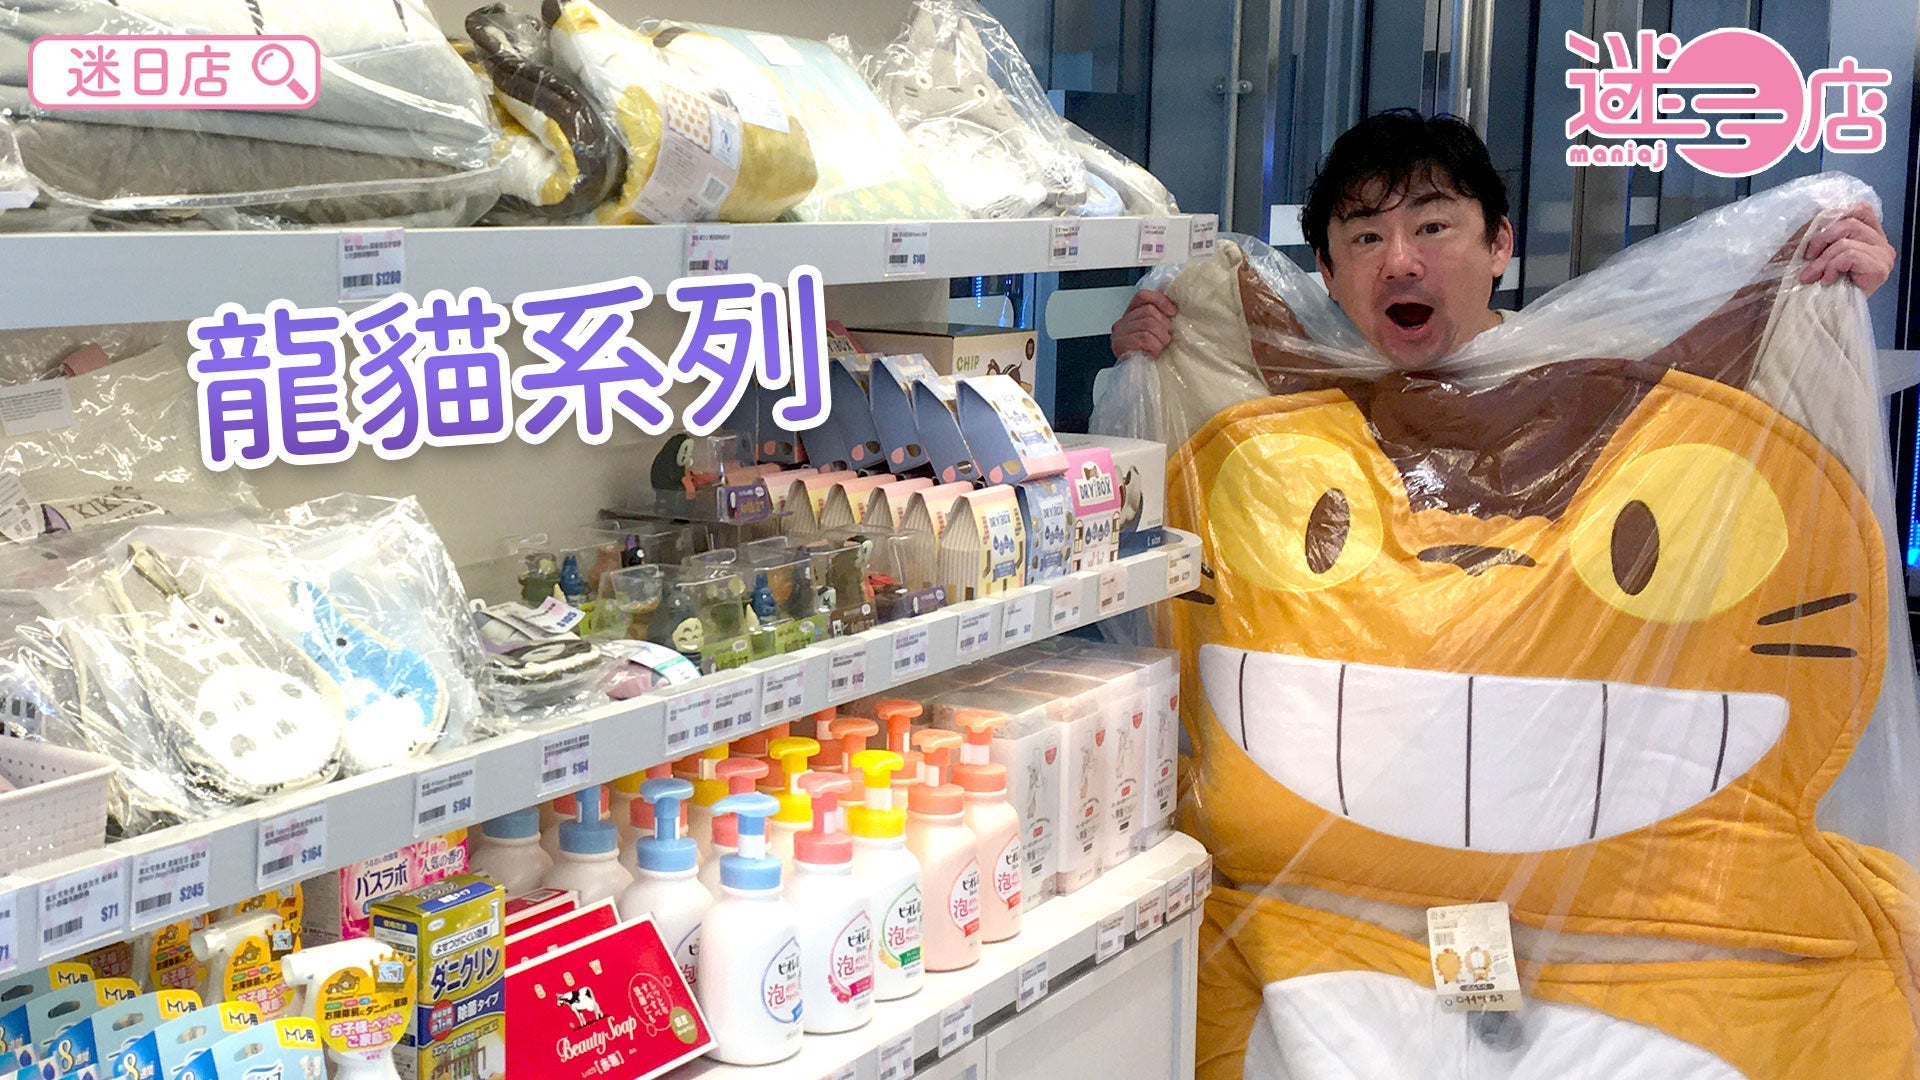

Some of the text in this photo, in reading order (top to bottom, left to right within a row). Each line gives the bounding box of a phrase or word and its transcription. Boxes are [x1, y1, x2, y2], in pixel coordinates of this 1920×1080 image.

[956, 355, 980, 371] CHIP
[1096, 478, 1112, 495] BOX
[420, 848, 465, 876] 人気の香り
[355, 857, 408, 900] バスラボ
[998, 871, 1012, 892] 泡
[179, 882, 204, 902] $245
[101, 902, 119, 922] $71
[953, 897, 968, 919] 泡
[888, 925, 906, 947] 泡
[430, 946, 500, 1000] ダニクリン
[837, 955, 855, 978] 泡
[767, 983, 786, 1007] 泡
[457, 991, 500, 1022] 除菌タイプ
[284, 1027, 315, 1043] トイレ用
[556, 1015, 637, 1062] Beauty Soap
